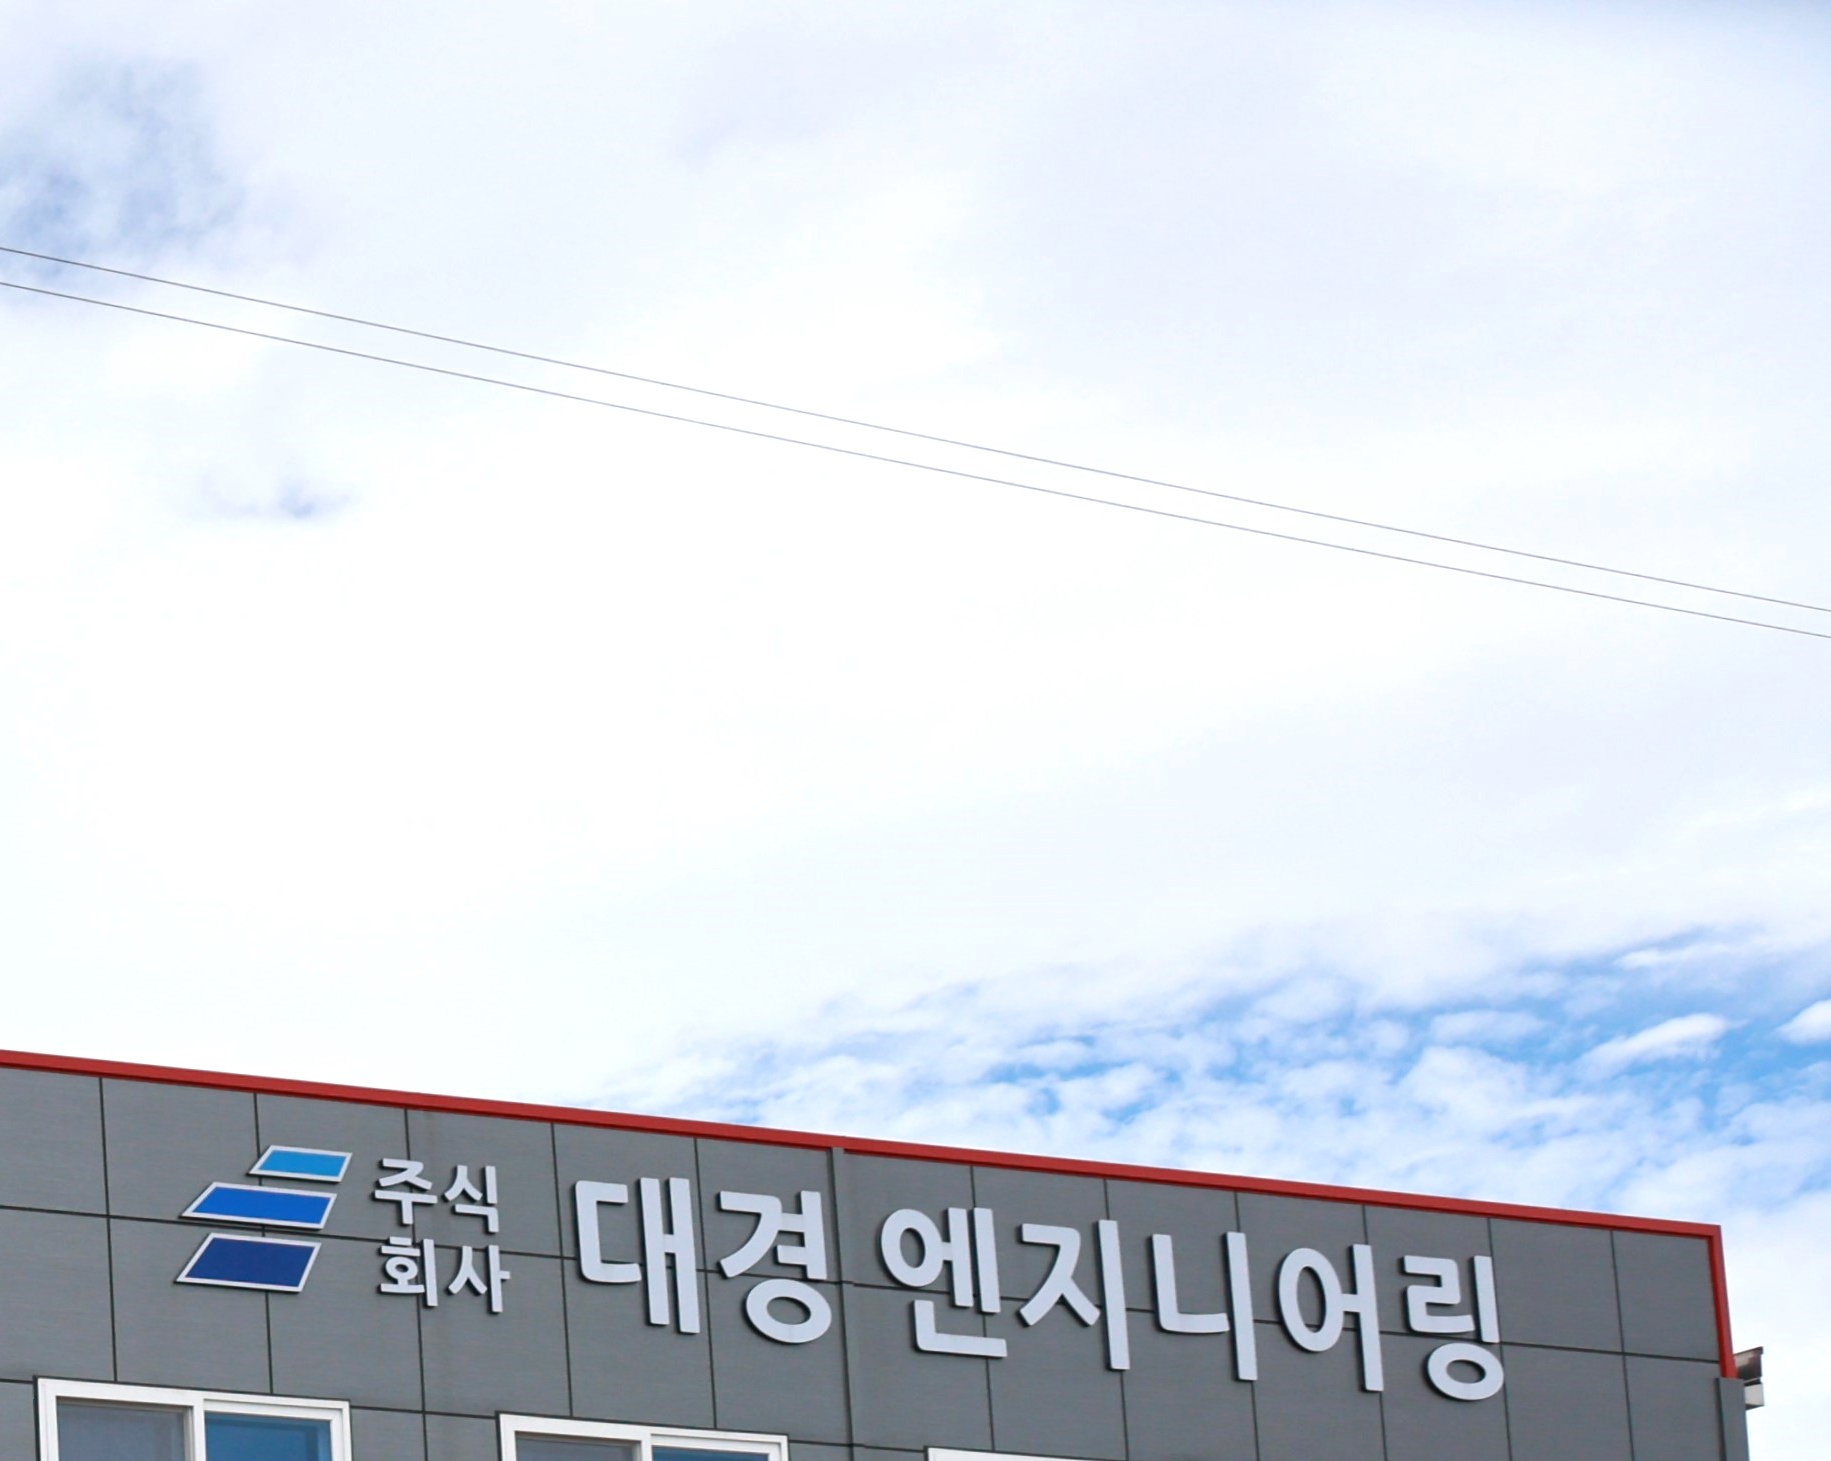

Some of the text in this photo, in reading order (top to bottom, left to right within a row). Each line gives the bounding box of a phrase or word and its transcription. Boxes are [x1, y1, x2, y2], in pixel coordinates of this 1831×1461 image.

[374, 1156, 500, 1237] 주식
[379, 1236, 511, 1315] 회사
[575, 1177, 1507, 1402] 대경 엔지니어링
